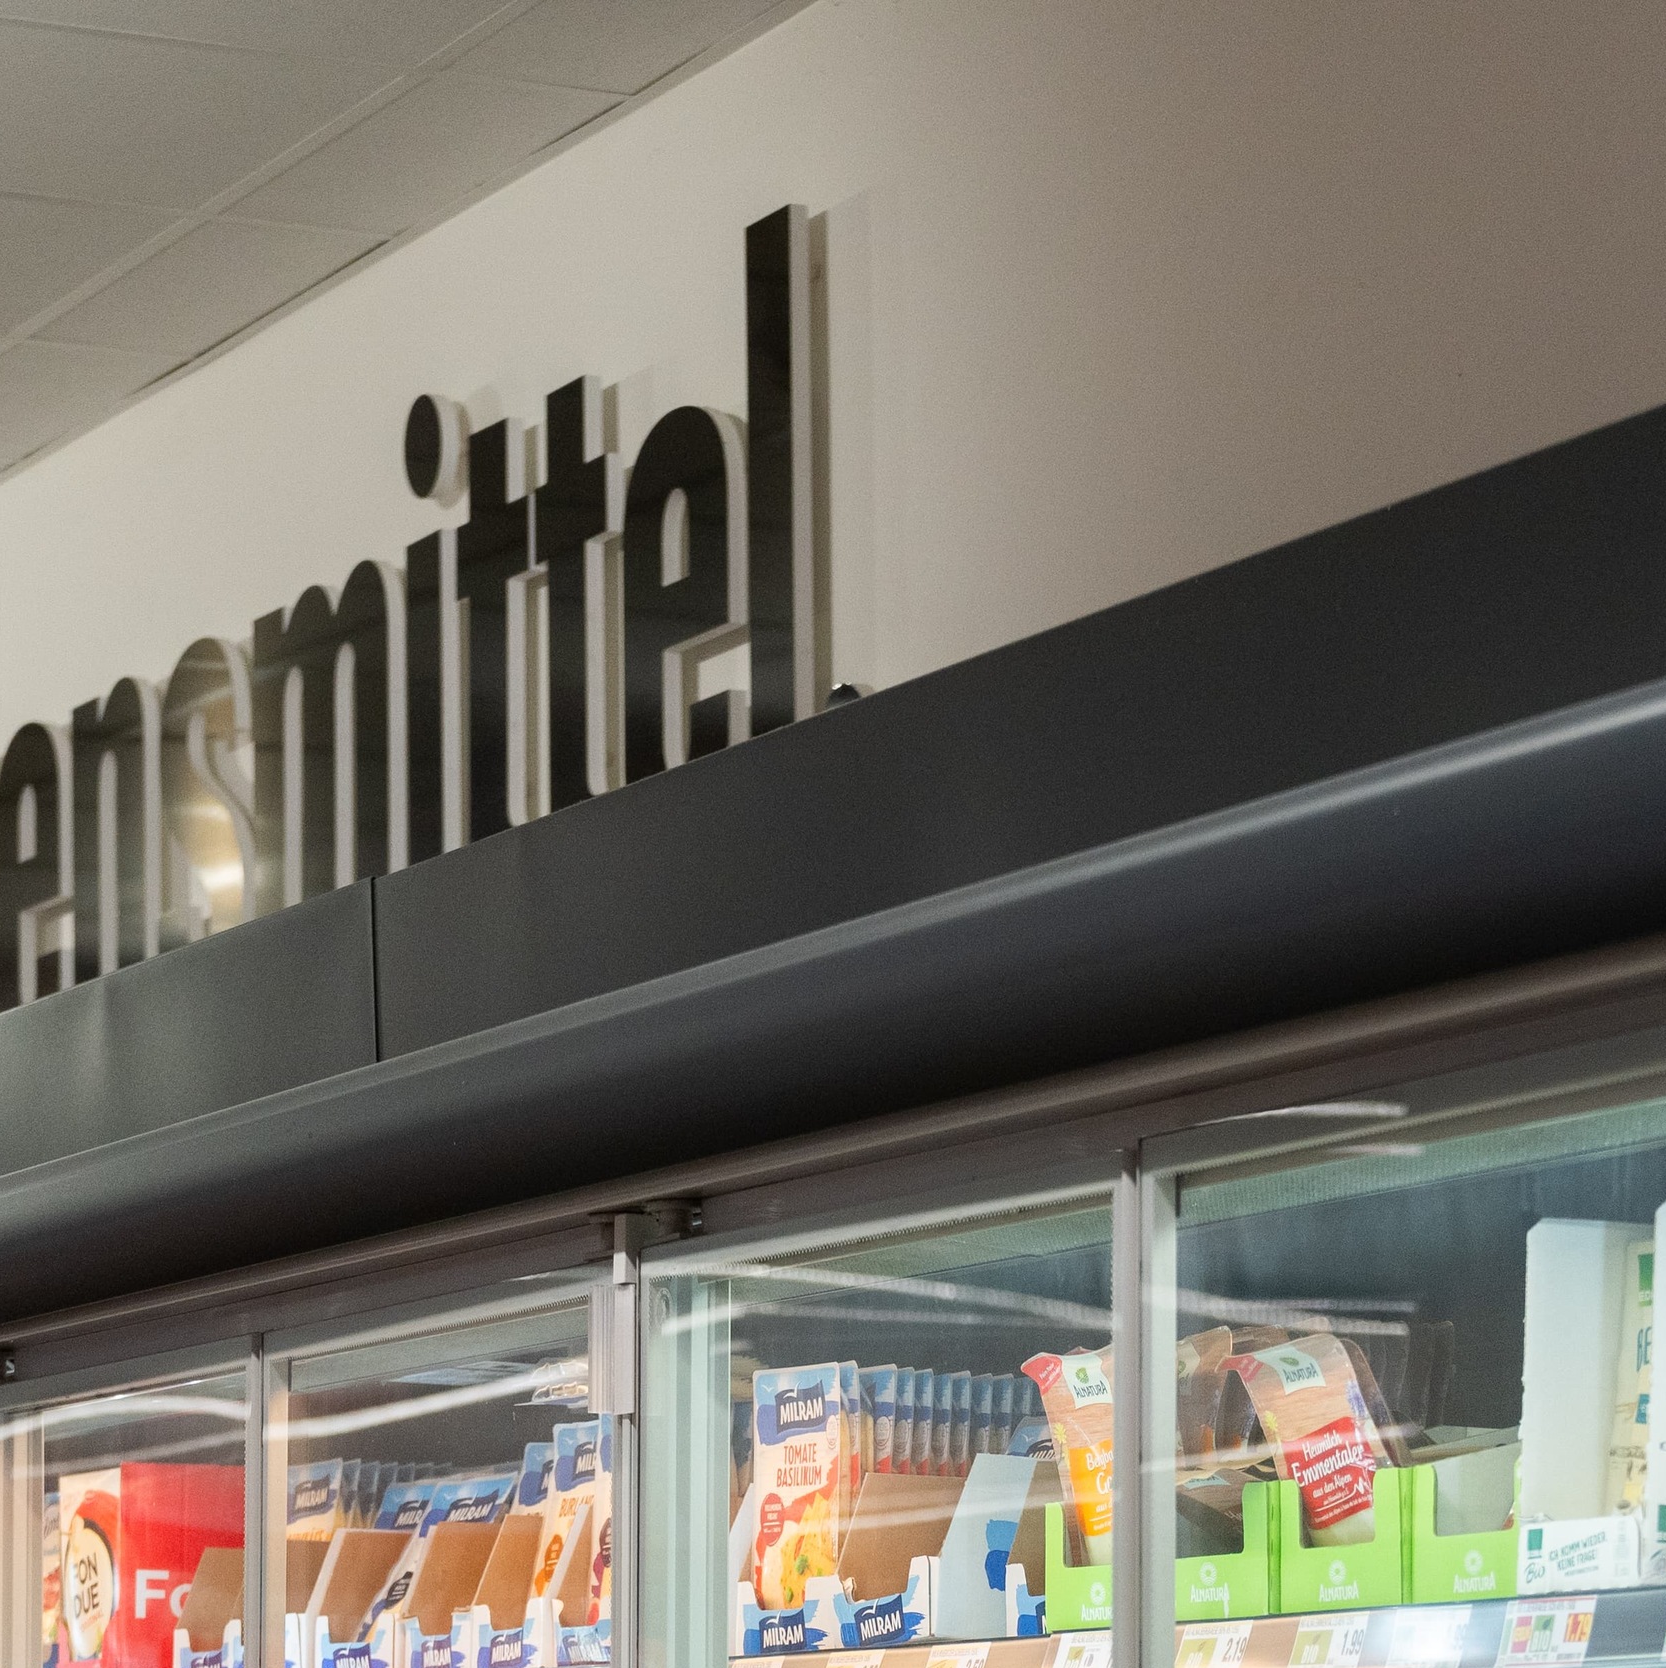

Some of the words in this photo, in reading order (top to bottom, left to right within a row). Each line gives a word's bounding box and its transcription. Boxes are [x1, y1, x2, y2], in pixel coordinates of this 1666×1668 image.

[1284, 1363, 1318, 1383] ALNATURA
[1074, 1380, 1108, 1399] ALNATURA
[779, 1397, 823, 1426] MILRAM
[783, 1443, 817, 1464] TOMATE
[1301, 1430, 1343, 1462] Heumilch
[776, 1464, 822, 1488] BASILIKUM
[1292, 1443, 1364, 1488] Emmentaler
[1312, 1485, 1324, 1499] aus
[1334, 1473, 1352, 1491] Alpen
[1560, 1538, 1581, 1556] KOMM
[1191, 1583, 1230, 1603] ALNATURA
[1319, 1581, 1359, 1602] ALNATURA
[1453, 1574, 1496, 1594] ALNATURA
[763, 1624, 803, 1648] MILRAM
[860, 1608, 901, 1644] MILRAM
[1565, 1612, 1593, 1642] 1.79
[491, 1641, 522, 1663] MILRAM
[1222, 1636, 1247, 1663] 2.19
[1341, 1629, 1365, 1656] 1.99
